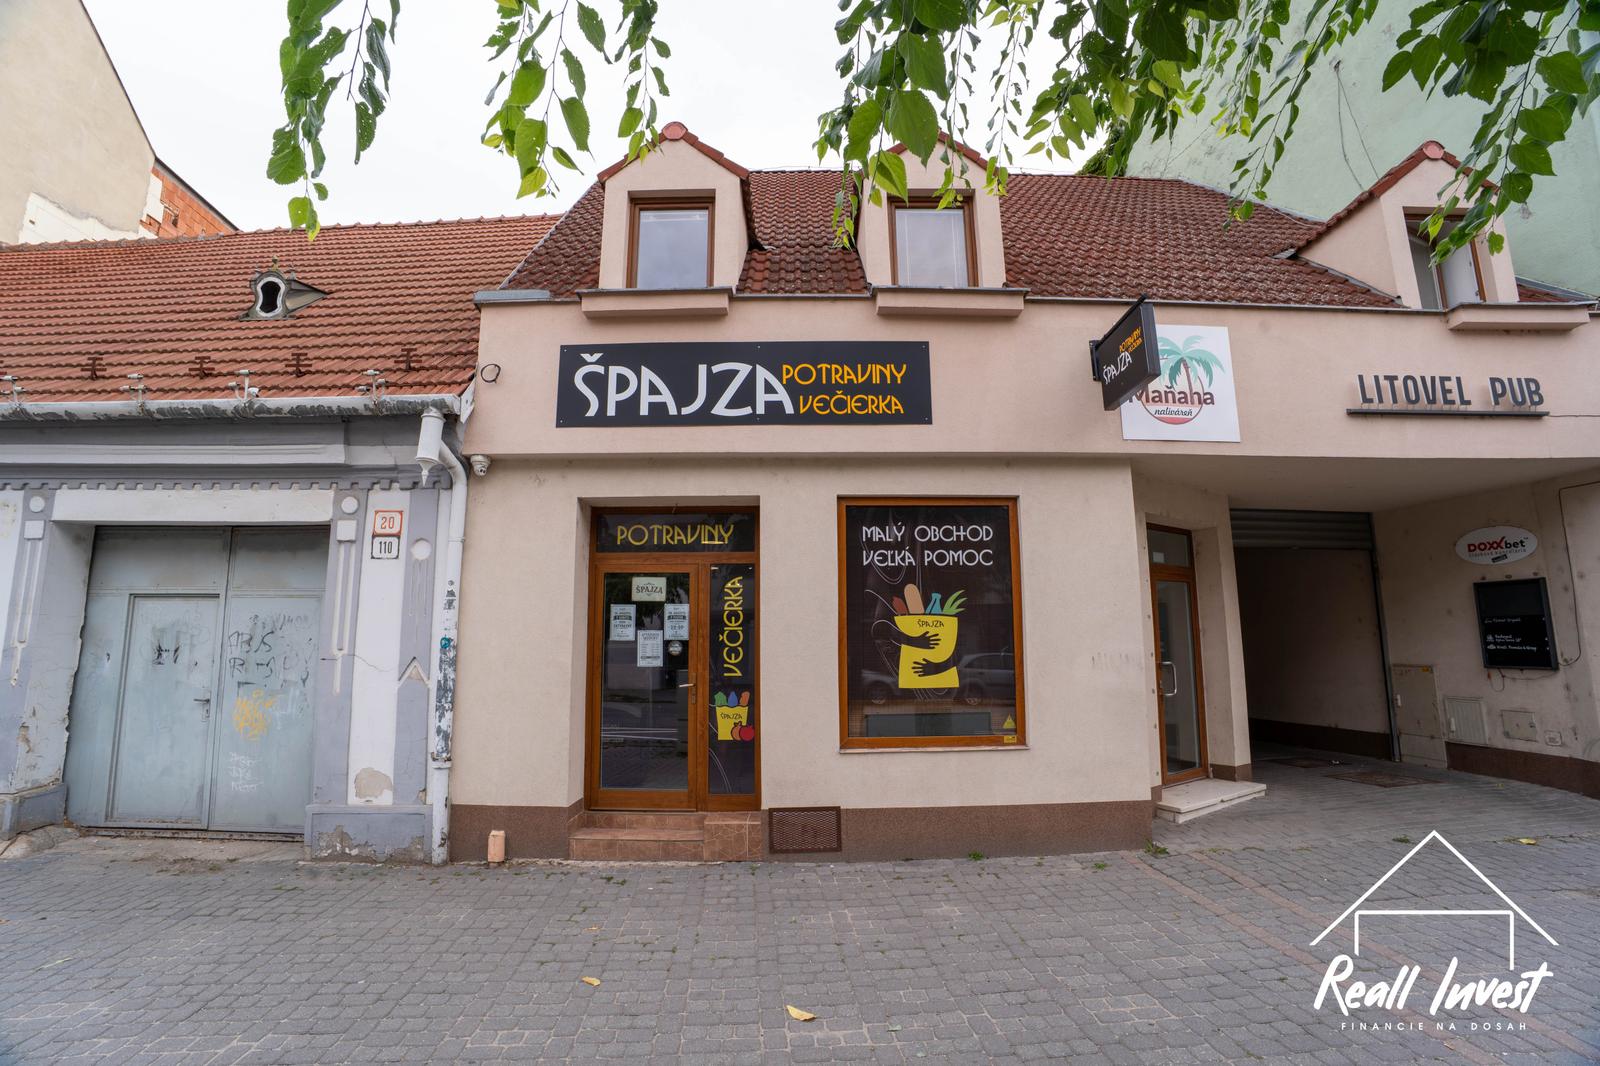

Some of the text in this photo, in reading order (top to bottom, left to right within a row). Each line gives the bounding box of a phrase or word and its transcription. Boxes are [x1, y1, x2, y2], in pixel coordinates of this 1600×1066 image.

[782, 363, 907, 385] POTRAVINY
[1103, 351, 1132, 385] ŠPAJZA
[574, 353, 795, 417] ŠPAJZA
[1357, 374, 1545, 406] LITOVEL PUB
[799, 390, 905, 415] VEČIERKA
[381, 516, 395, 529] 20
[862, 522, 994, 542] MALÝ OBCHOD
[616, 524, 734, 546] POTRAVINY
[379, 541, 393, 554] 110
[924, 549, 994, 566] POMOC
[635, 584, 664, 595] ŠPAJZA
[718, 576, 744, 677] VEČIERKA
[917, 619, 945, 628] ŠPAJZA
